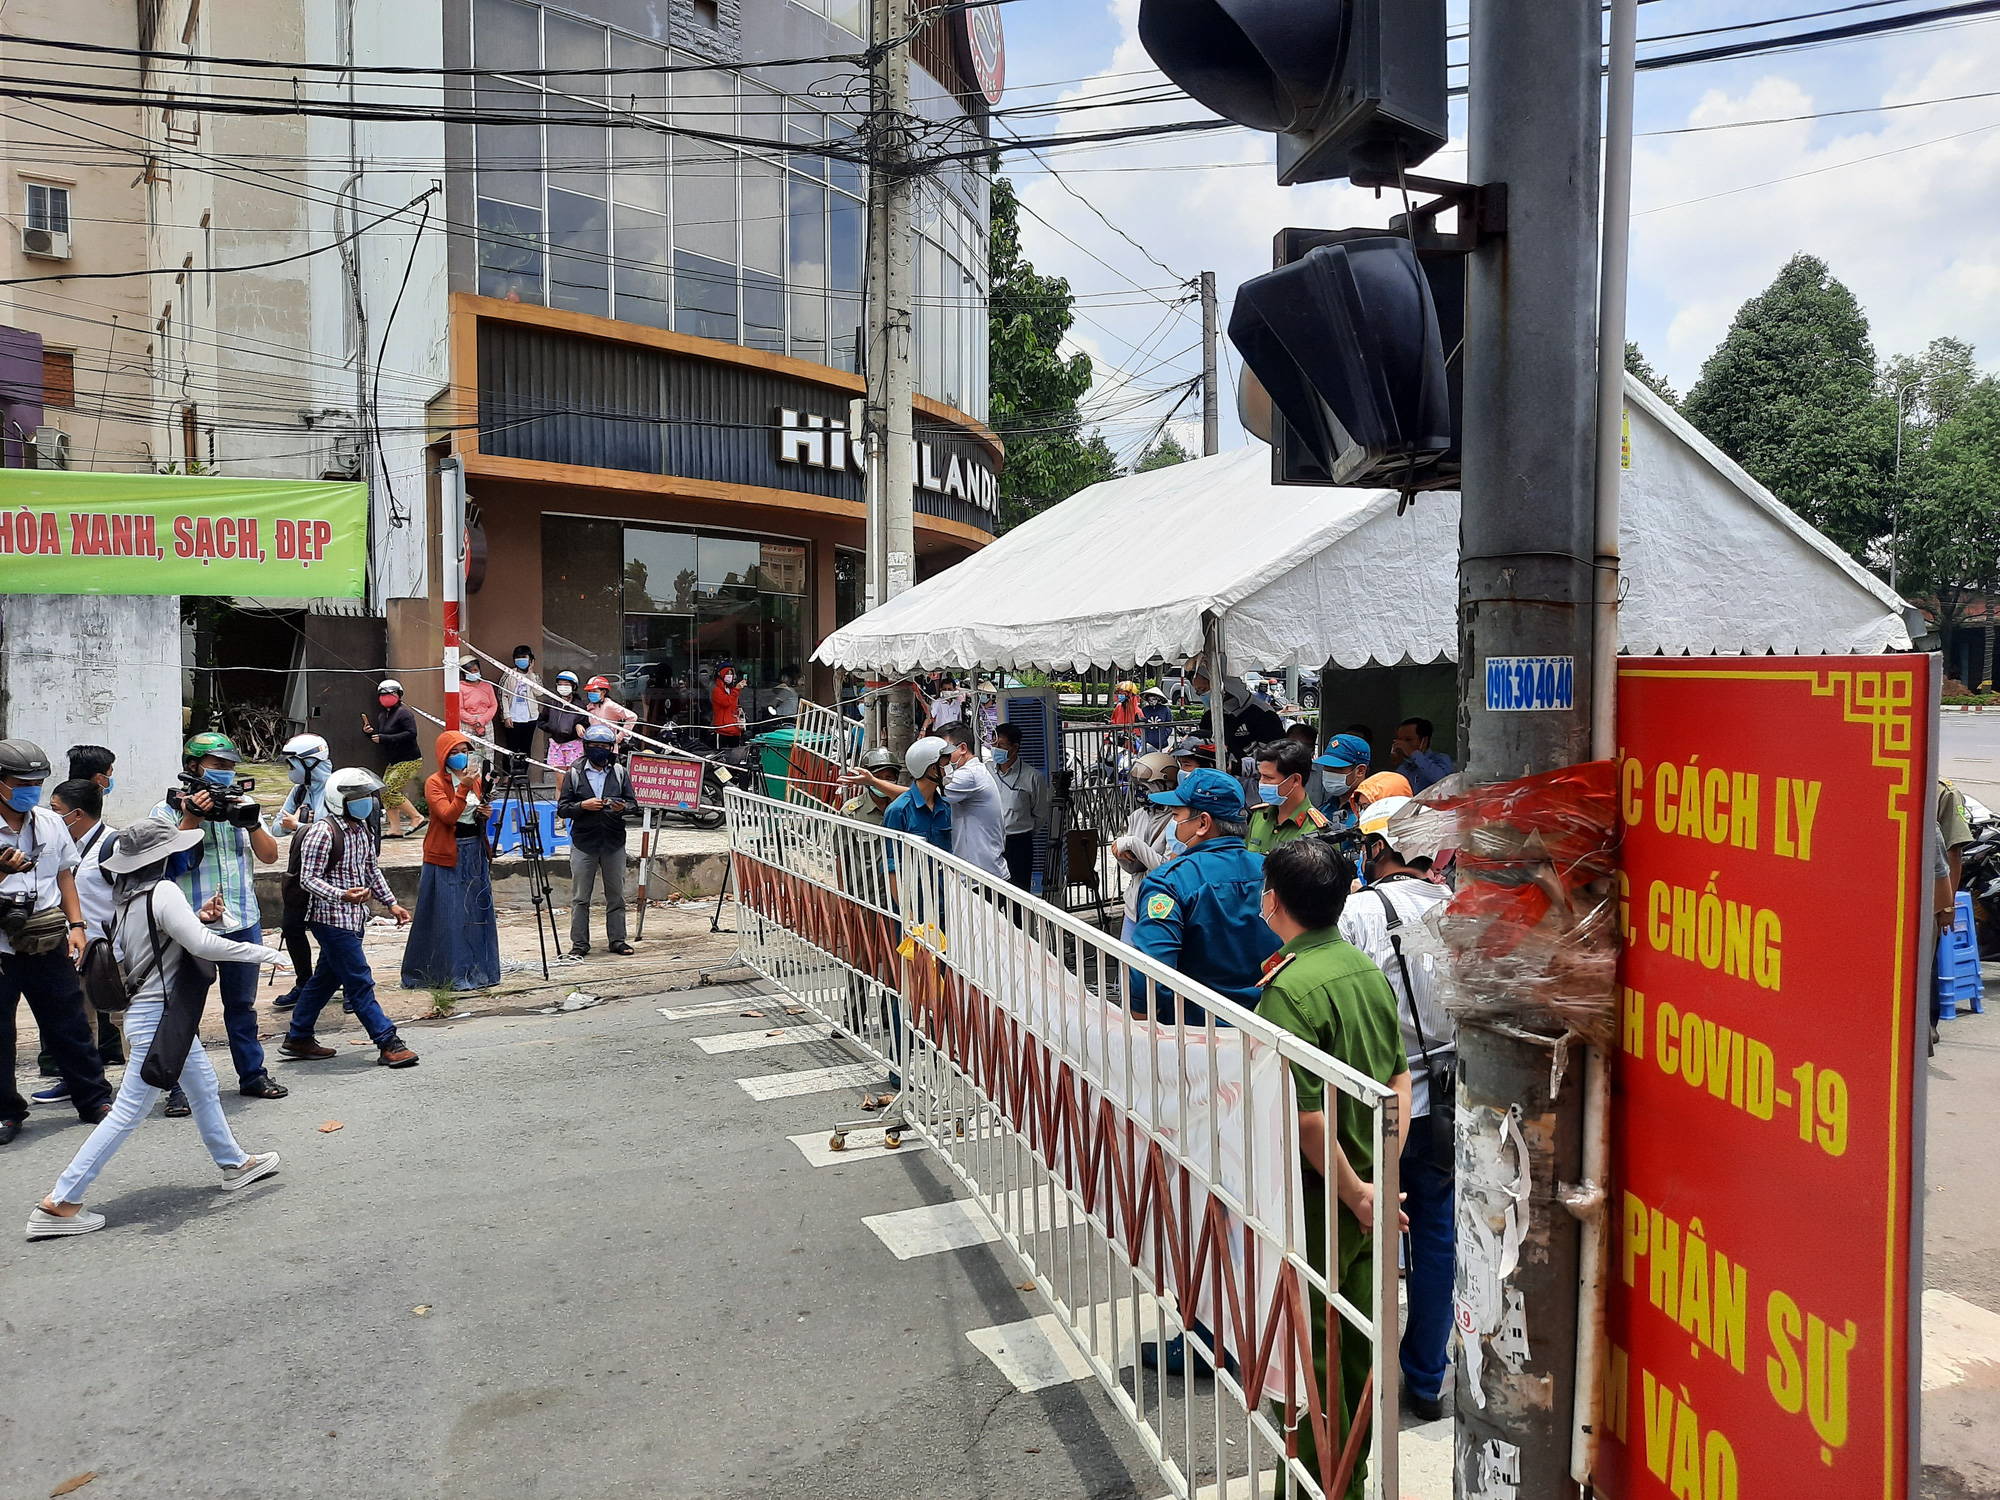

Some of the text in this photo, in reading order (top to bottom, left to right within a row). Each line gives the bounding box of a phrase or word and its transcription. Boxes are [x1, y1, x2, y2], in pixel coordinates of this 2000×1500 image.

[0, 505, 331, 568] HÒA XANH, SẠCH, ĐẸP
[1487, 663, 1573, 709] 0916.30.40.40
[638, 775, 657, 785] PHẠM
[667, 779, 683, 788] PHẠT
[659, 766, 672, 775] RÁC
[1656, 755, 1759, 850] CÁCH
[1774, 777, 1822, 861] LY
[1648, 871, 1782, 991] CHỐNG
[1656, 1001, 1848, 1157] COVID-19
[1622, 1189, 1857, 1467] PHẬN SỰ
[1642, 1367, 1738, 1500] VÀO
